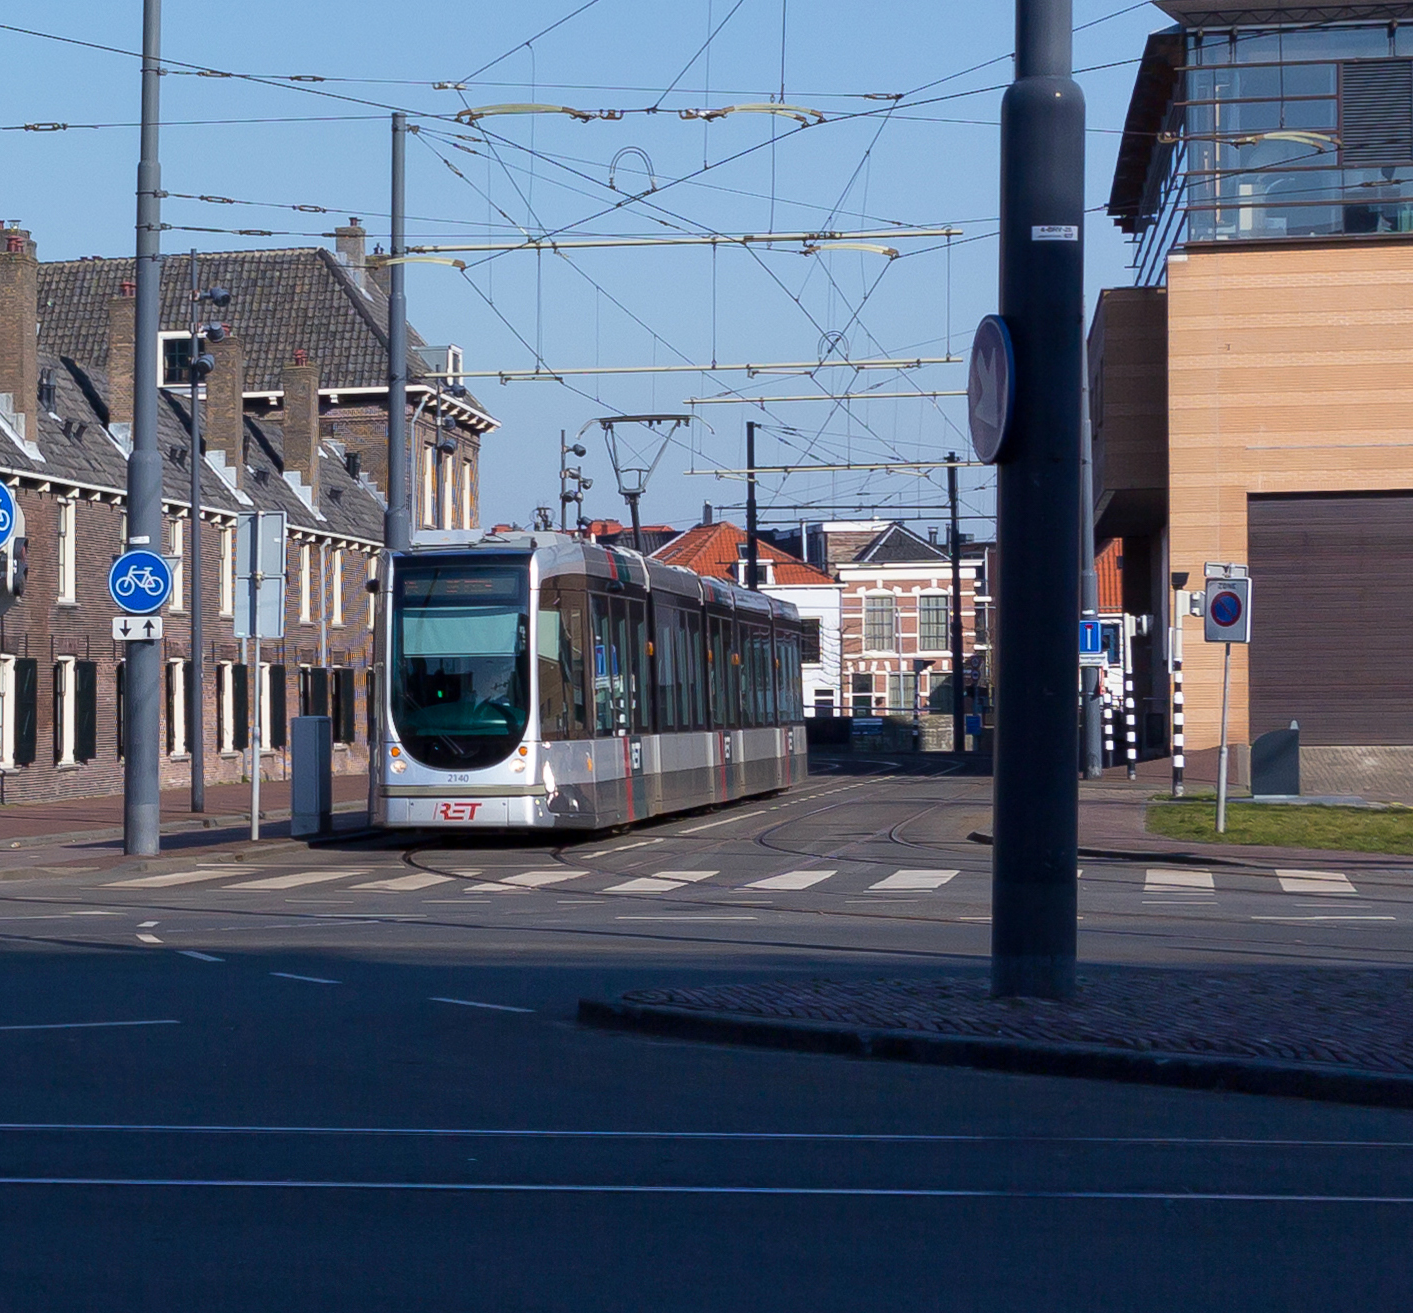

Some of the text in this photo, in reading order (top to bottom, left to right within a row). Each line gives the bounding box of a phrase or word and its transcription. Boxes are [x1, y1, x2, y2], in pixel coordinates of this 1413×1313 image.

[1217, 582, 1237, 590] ZONE
[447, 774, 469, 783] 2140
[439, 803, 482, 820] RET
